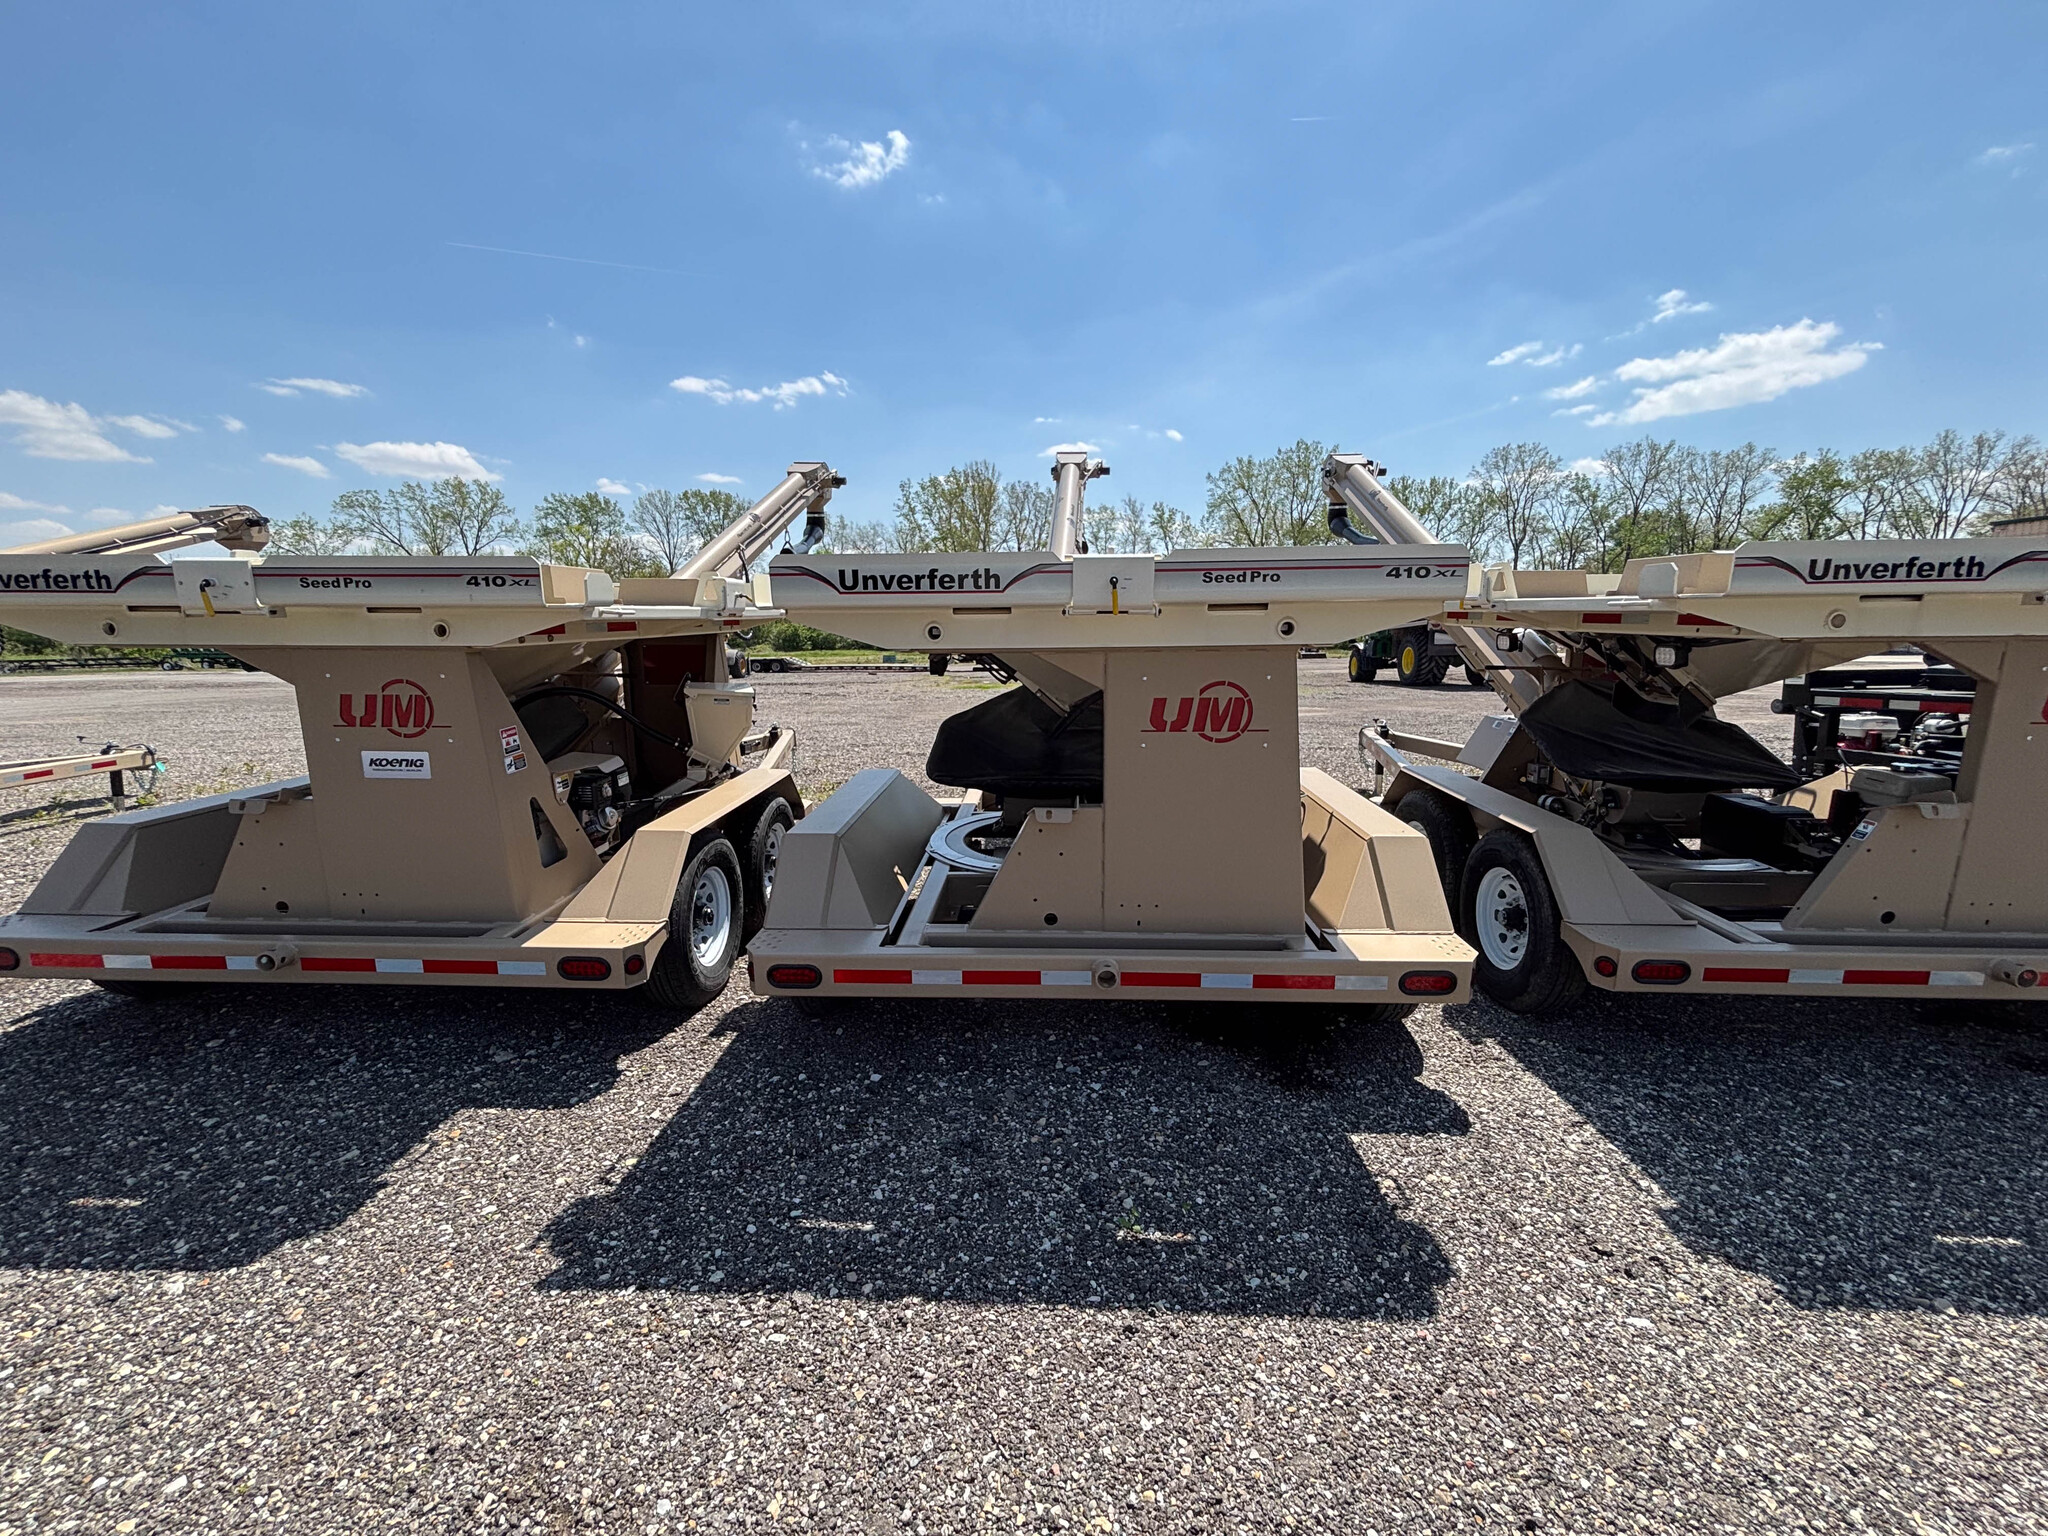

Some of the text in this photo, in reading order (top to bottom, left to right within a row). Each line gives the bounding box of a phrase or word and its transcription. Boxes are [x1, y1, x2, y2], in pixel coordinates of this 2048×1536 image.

[1385, 566, 1464, 579] 410 XL
[1808, 556, 1985, 580] Unverferth
[466, 575, 537, 588] 410 XL
[838, 568, 1001, 591] Unverferth
